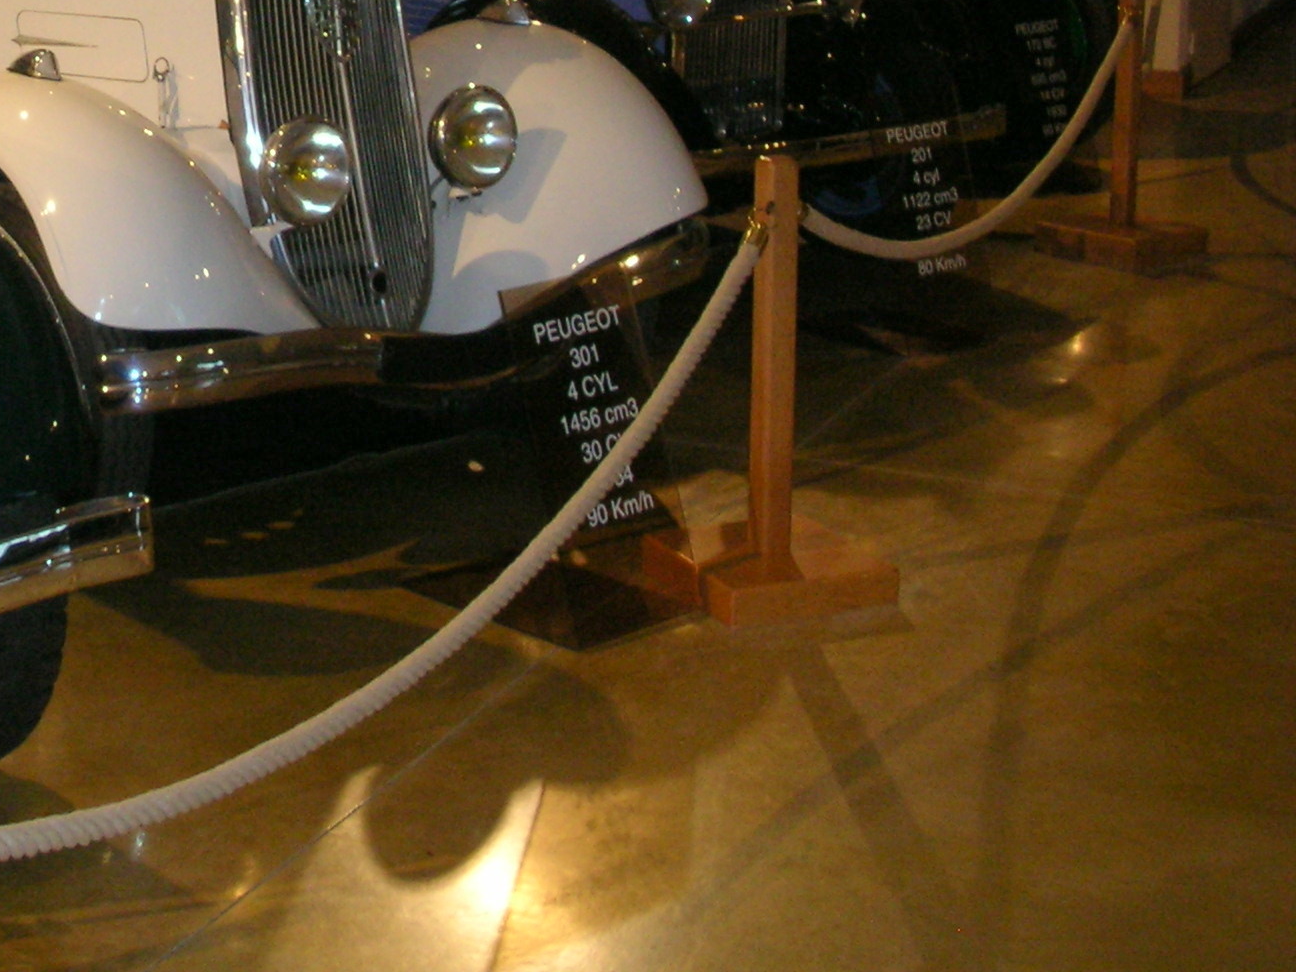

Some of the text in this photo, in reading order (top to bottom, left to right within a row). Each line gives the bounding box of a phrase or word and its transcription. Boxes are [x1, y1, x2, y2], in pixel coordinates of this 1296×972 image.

[1014, 18, 1059, 36] PEUGEOT
[886, 120, 949, 144] PEUGEOT
[911, 146, 933, 164] 201
[913, 167, 941, 187] 4 cyl
[902, 186, 959, 209] 1122 cm3
[916, 210, 952, 231] 23 CV
[917, 254, 967, 276] 80 Km/h
[532, 305, 620, 345] PEUGEOT
[569, 343, 600, 368] 301
[567, 370, 619, 401] 4 CYL
[560, 397, 639, 435] 1456 cm3
[581, 433, 621, 464] 30 C
[610, 490, 655, 520] Km/h
